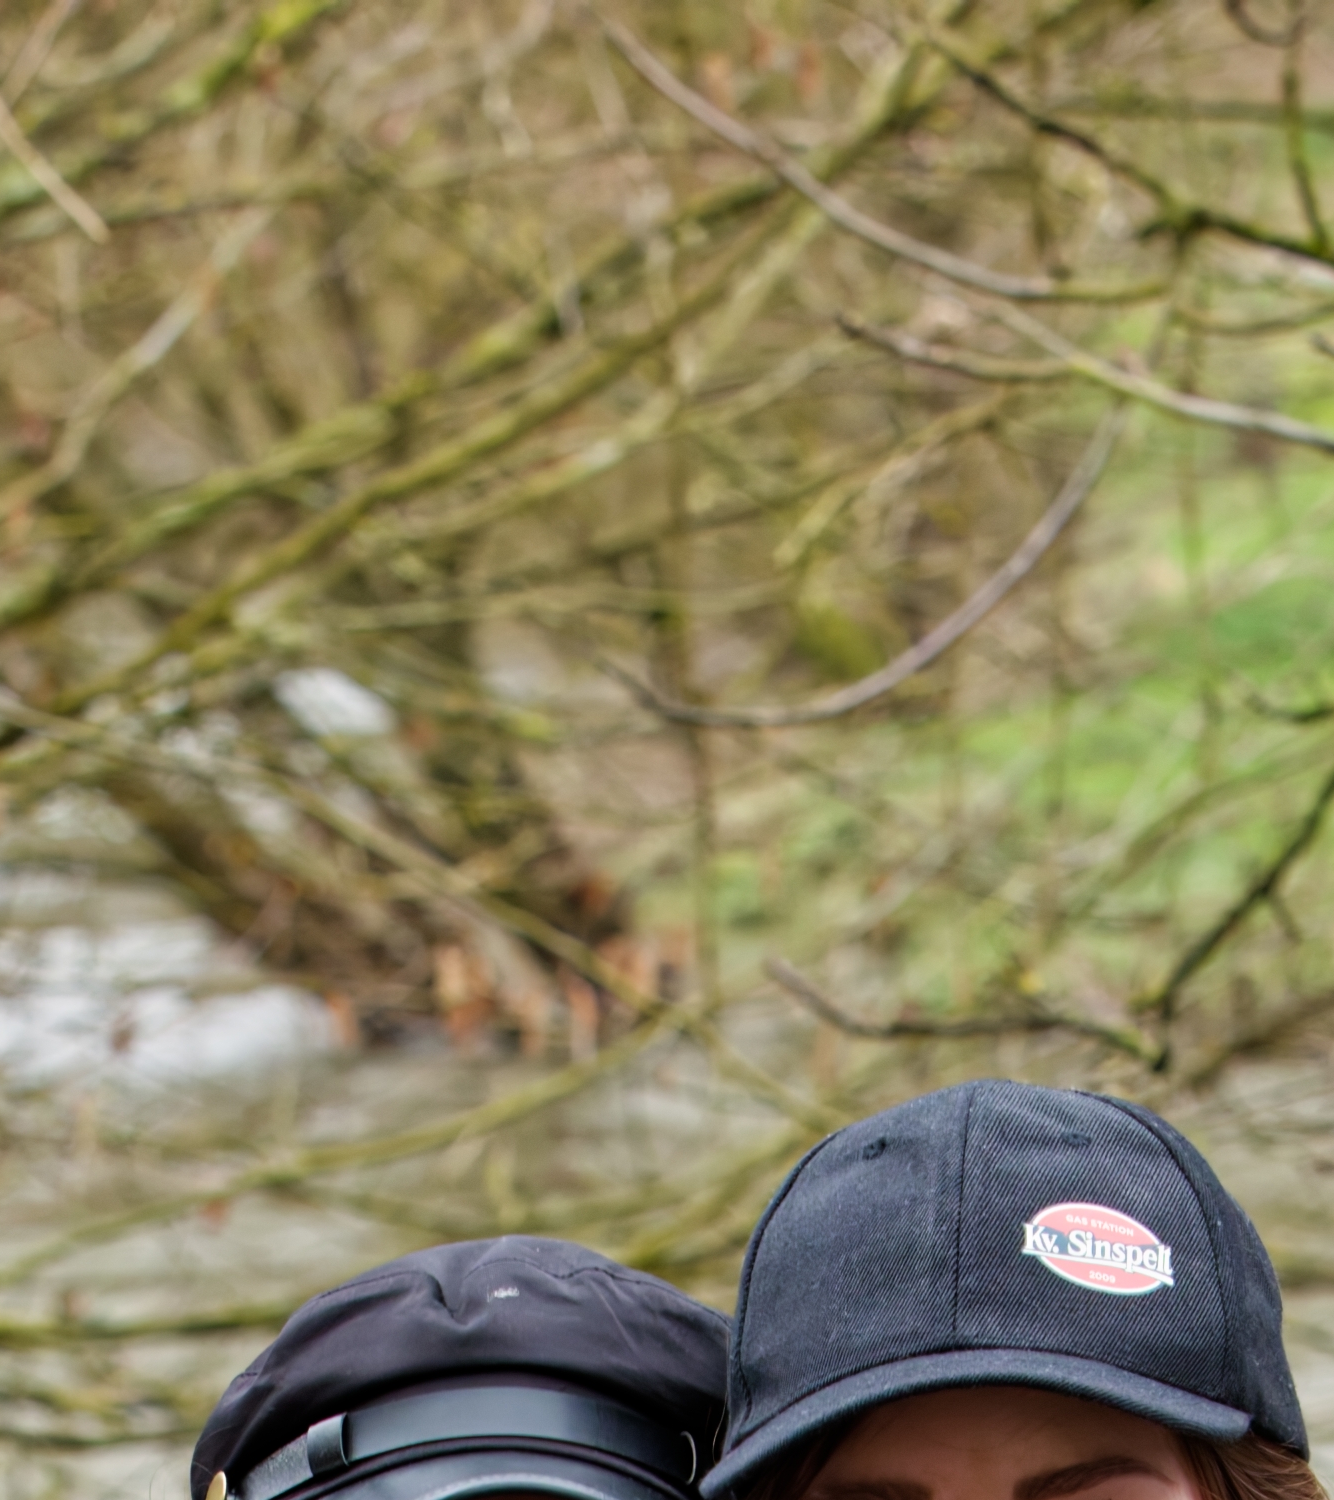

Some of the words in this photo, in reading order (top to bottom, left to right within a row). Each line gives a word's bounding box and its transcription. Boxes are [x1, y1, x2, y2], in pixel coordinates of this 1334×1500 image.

[1065, 1213, 1088, 1226] GAS
[1090, 1218, 1135, 1237] STATION
[1024, 1223, 1059, 1253] Kv.
[1067, 1229, 1174, 1275] Sinspelt
[1088, 1270, 1116, 1284] 2009
